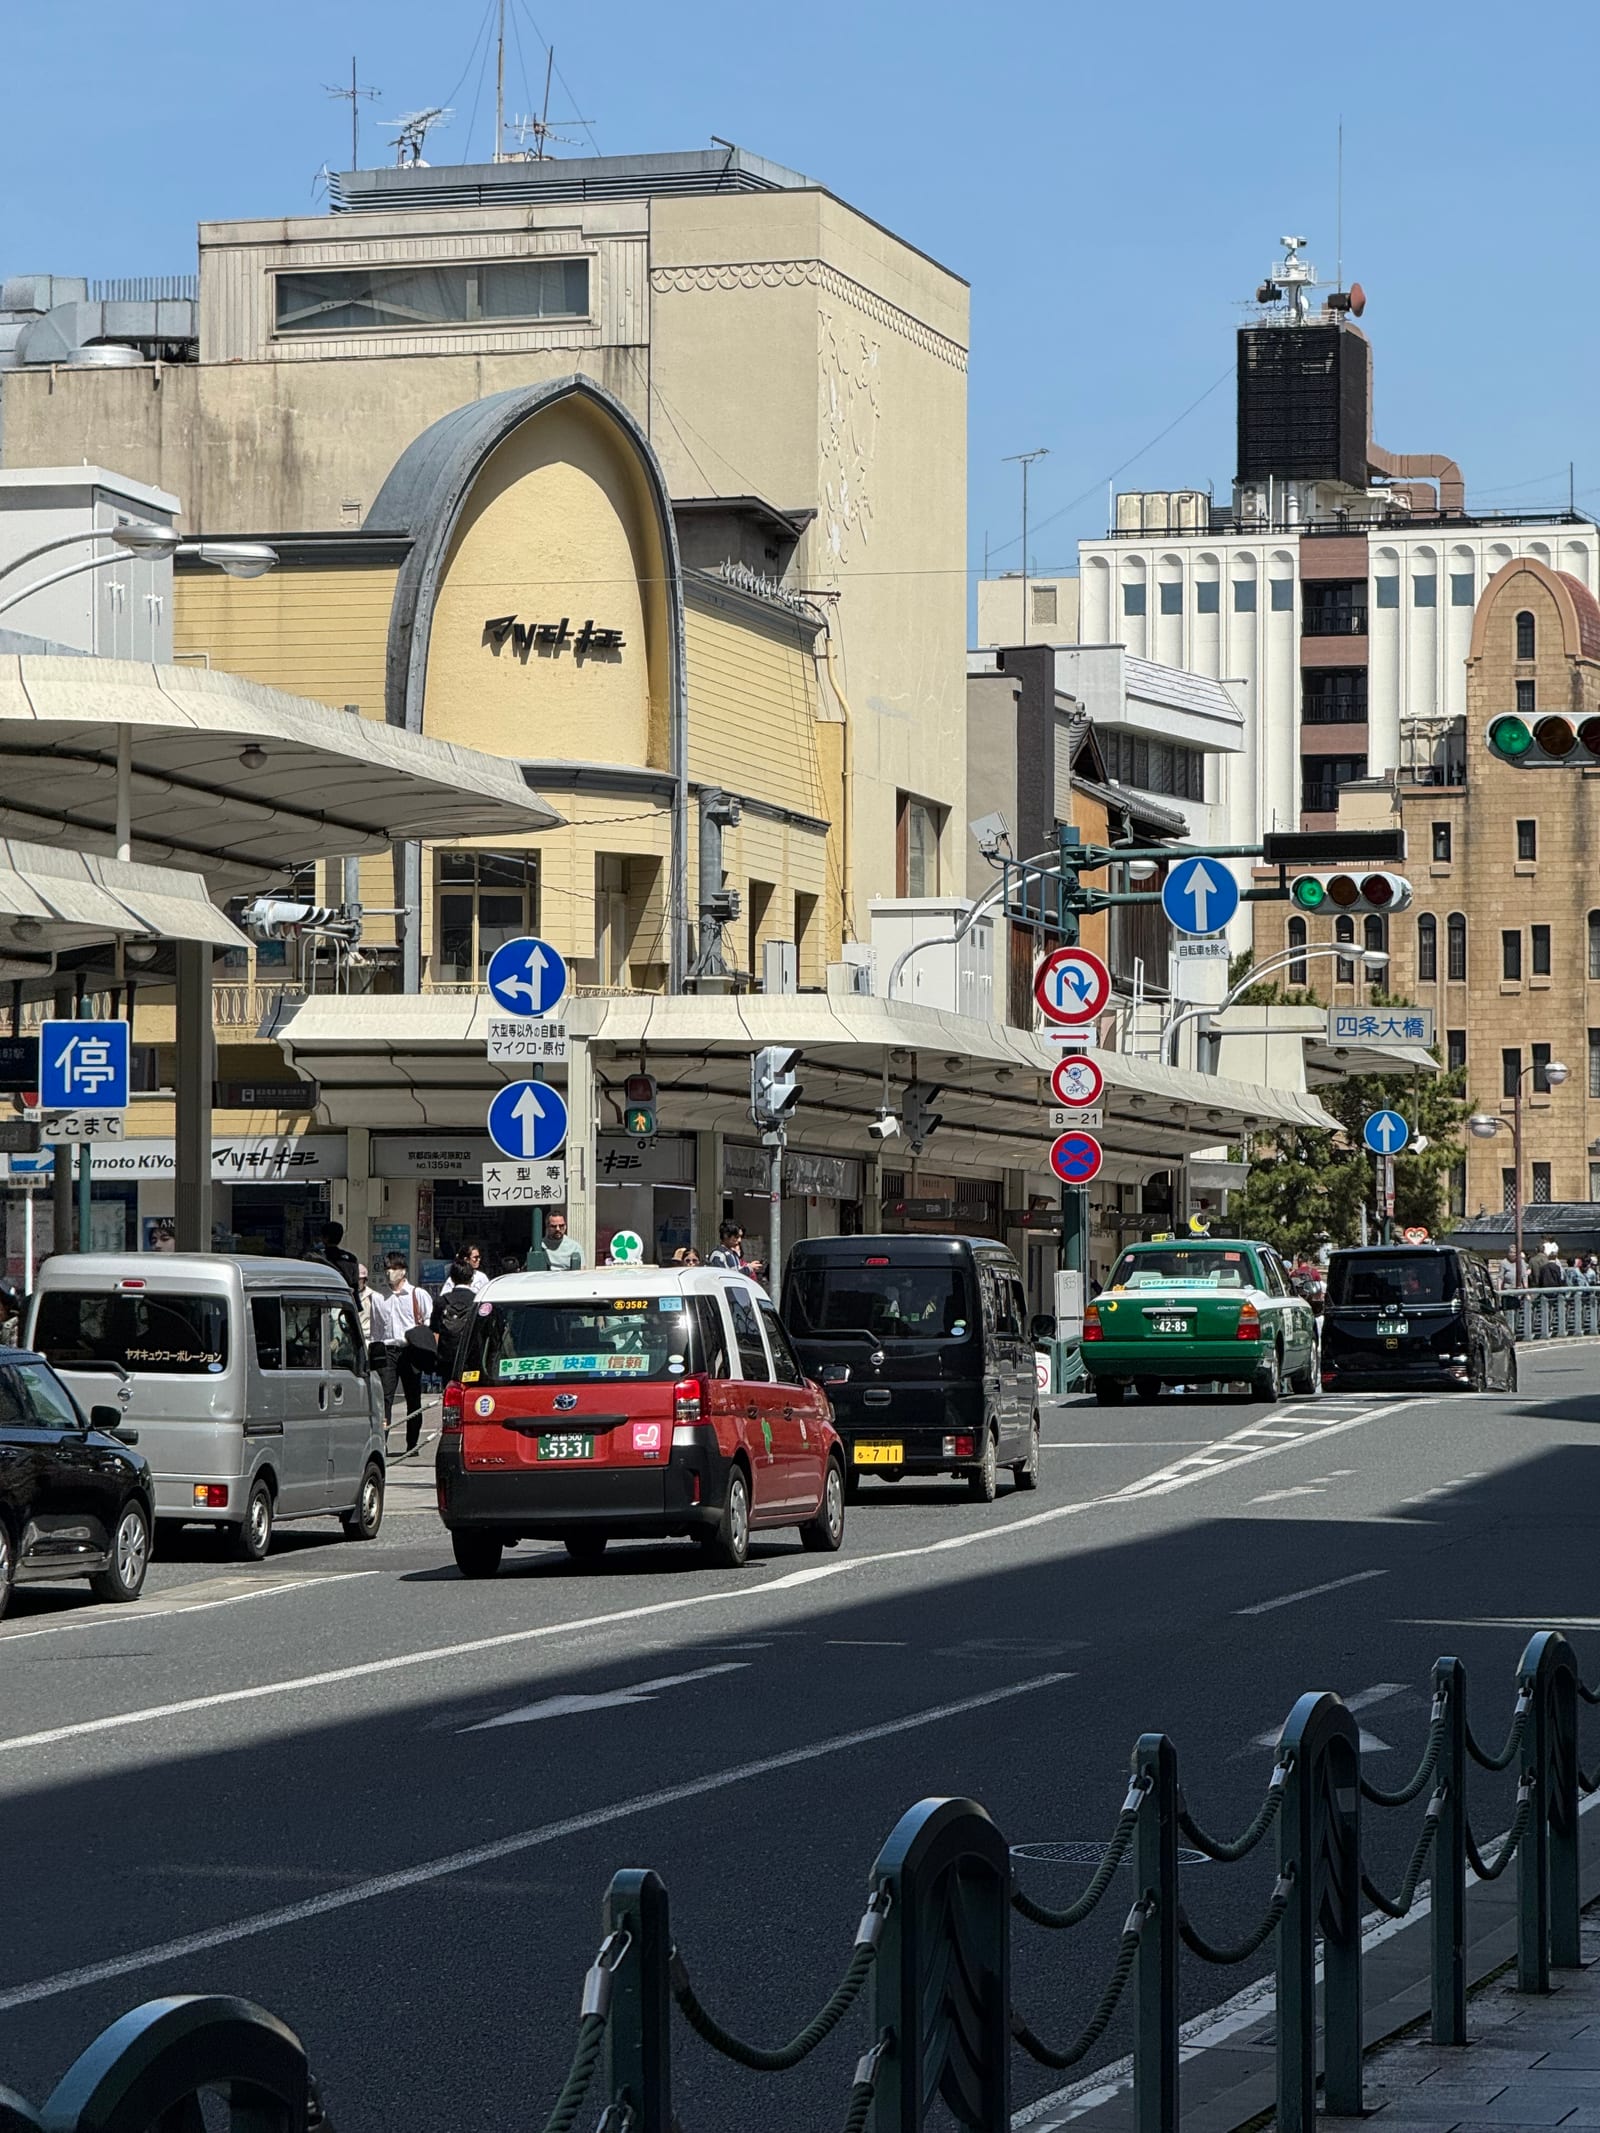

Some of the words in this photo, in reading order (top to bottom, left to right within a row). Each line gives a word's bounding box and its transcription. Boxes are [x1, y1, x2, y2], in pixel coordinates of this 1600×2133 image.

[484, 614, 626, 653] マツモトキヨシ
[1180, 944, 1226, 957] 自転車を除く
[491, 1023, 566, 1038] 大型等以外の自動車
[1336, 1016, 1424, 1038] 四条大橋
[491, 1041, 566, 1056] マイクロ・原付
[54, 1036, 115, 1093] 停
[45, 1117, 121, 1136] ここまで
[212, 1146, 320, 1172] マツモトキヨシ
[1119, 1218, 1157, 1227] タニグチ
[625, 1300, 648, 1309] 3582
[1159, 1321, 1188, 1332] 42-89
[125, 1348, 222, 1363] ヤオキュウコーポレーション
[518, 1358, 552, 1372] 安全
[563, 1356, 597, 1369] 快適
[608, 1355, 644, 1369] 信頼
[549, 1441, 590, 1457] 53-31
